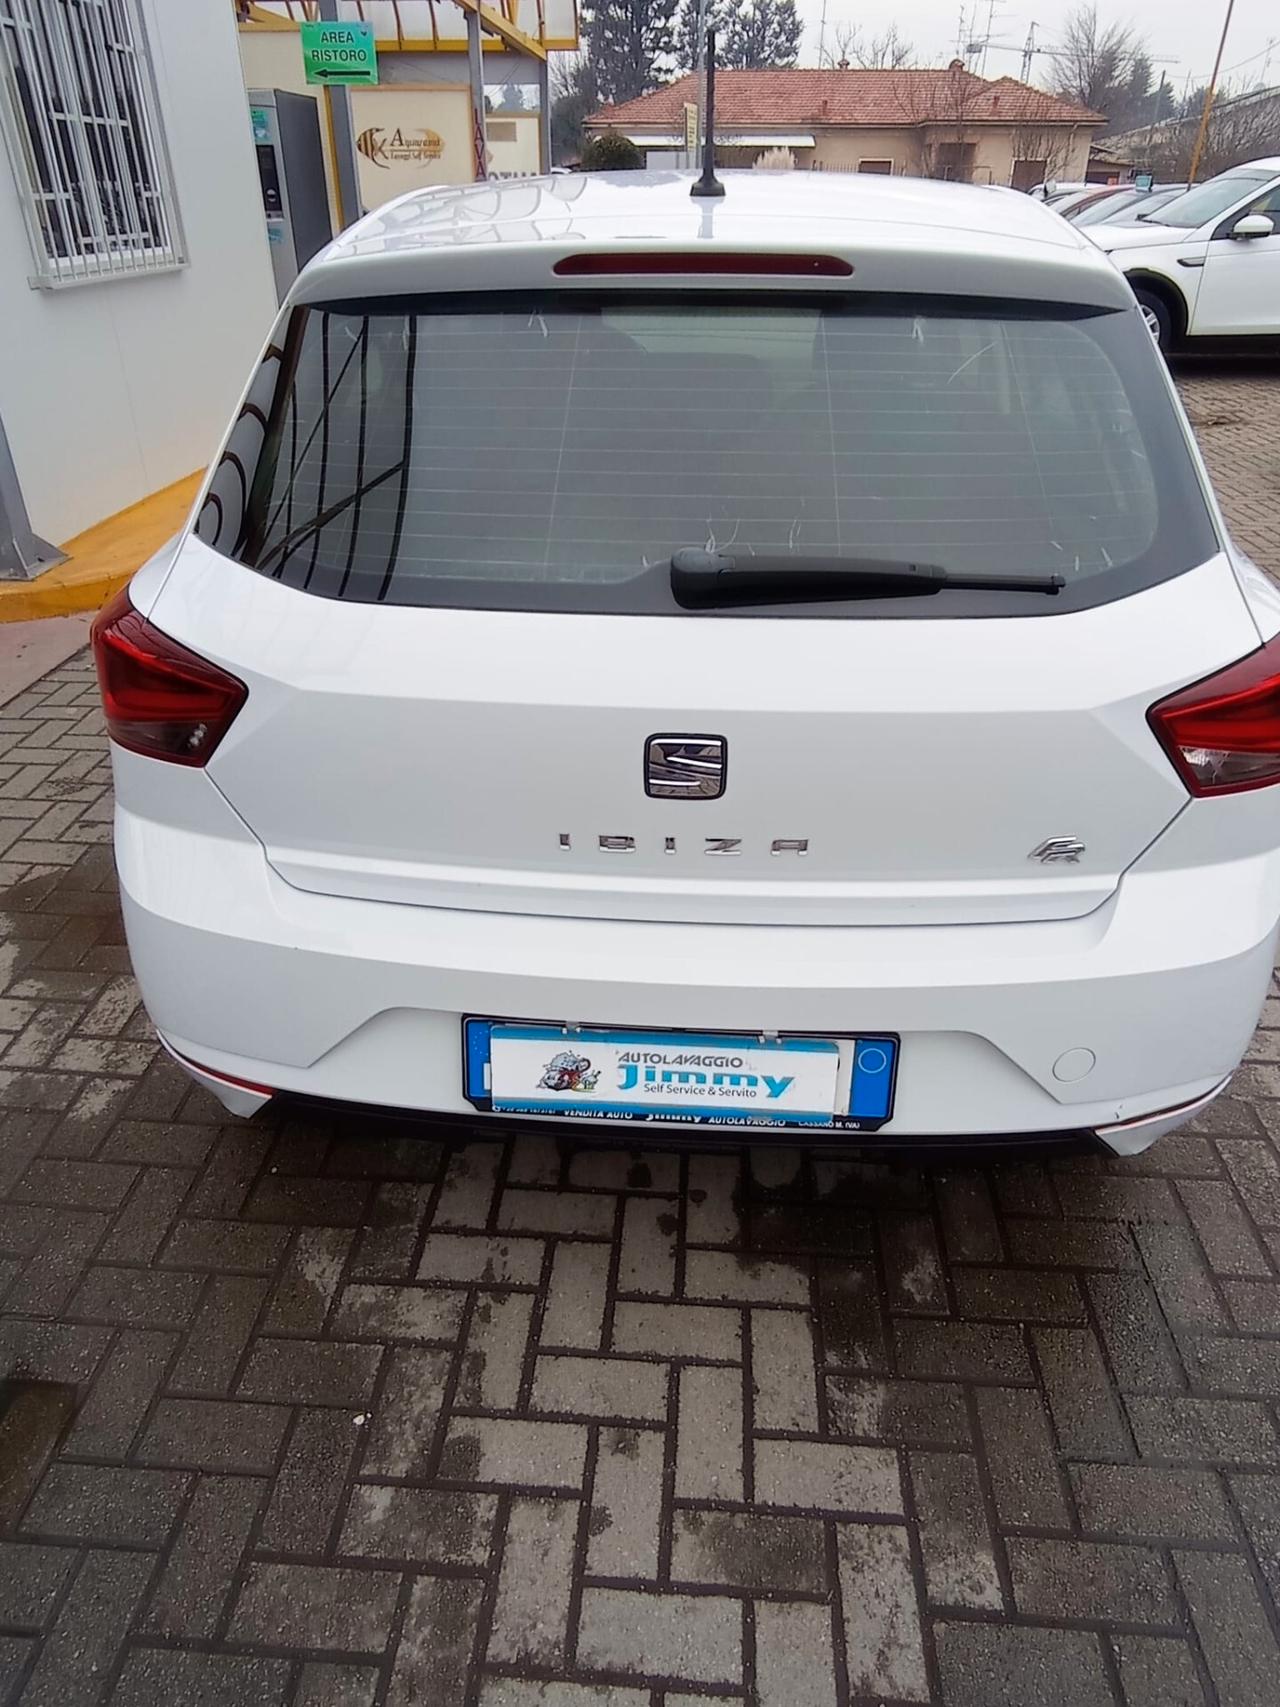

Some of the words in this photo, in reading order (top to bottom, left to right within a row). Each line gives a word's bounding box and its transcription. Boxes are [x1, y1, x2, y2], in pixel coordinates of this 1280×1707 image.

[321, 31, 354, 43] AREA
[311, 49, 367, 62] RISTORO
[558, 832, 810, 857] IBIZA
[617, 1051, 744, 1069] AUTOLAVAGGIO
[616, 1063, 796, 1099] Jimmy
[643, 1082, 665, 1094] Self
[666, 1084, 706, 1097] Service
[707, 1087, 716, 1097] &
[718, 1088, 757, 1098] Servito
[564, 1109, 605, 1119] VENDITA
[606, 1111, 634, 1120] AUTO
[708, 1115, 787, 1128] AUTOLAVAGGIO
